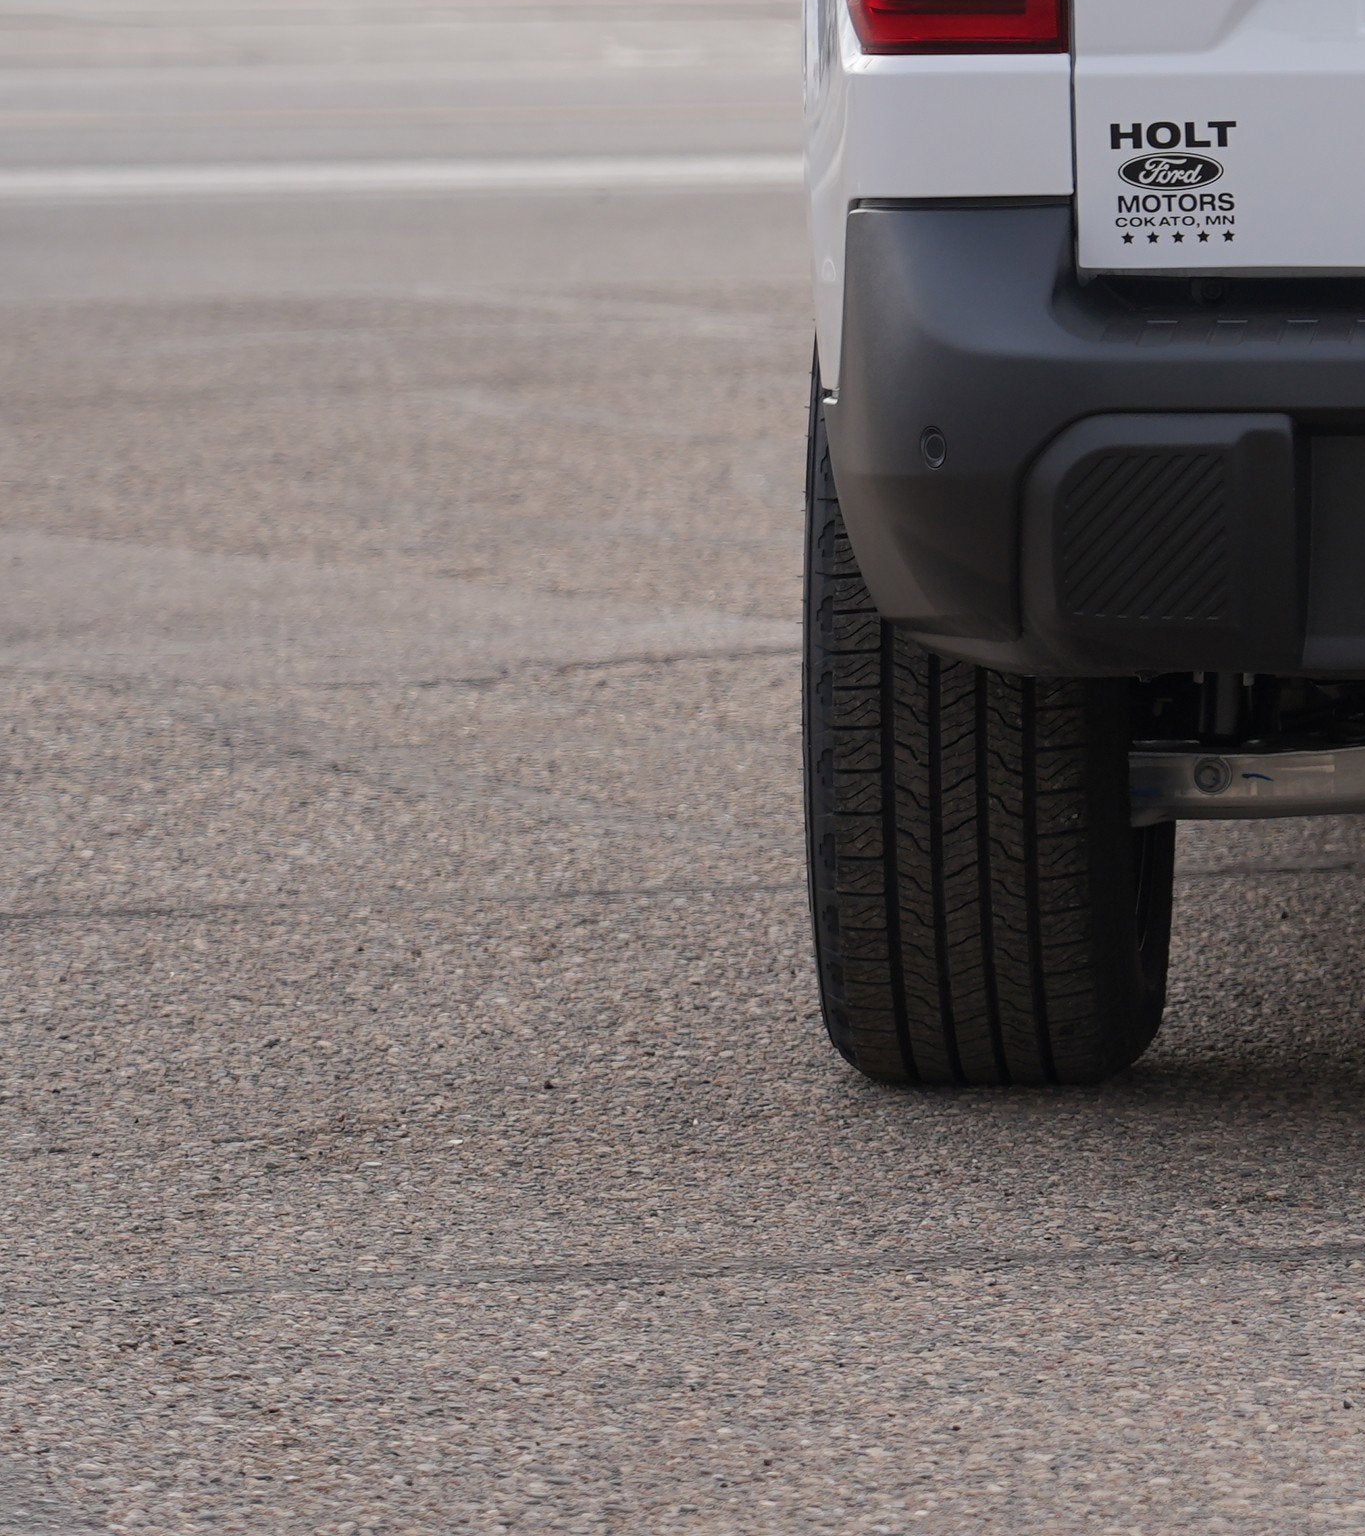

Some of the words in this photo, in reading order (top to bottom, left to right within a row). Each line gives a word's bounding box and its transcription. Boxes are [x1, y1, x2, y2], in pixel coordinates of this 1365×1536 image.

[1110, 121, 1237, 149] HOLT
[1138, 158, 1203, 184] Ford
[1117, 192, 1235, 213] MOTORS
[1115, 215, 1200, 228] COKATO,
[1205, 215, 1235, 225] MN
